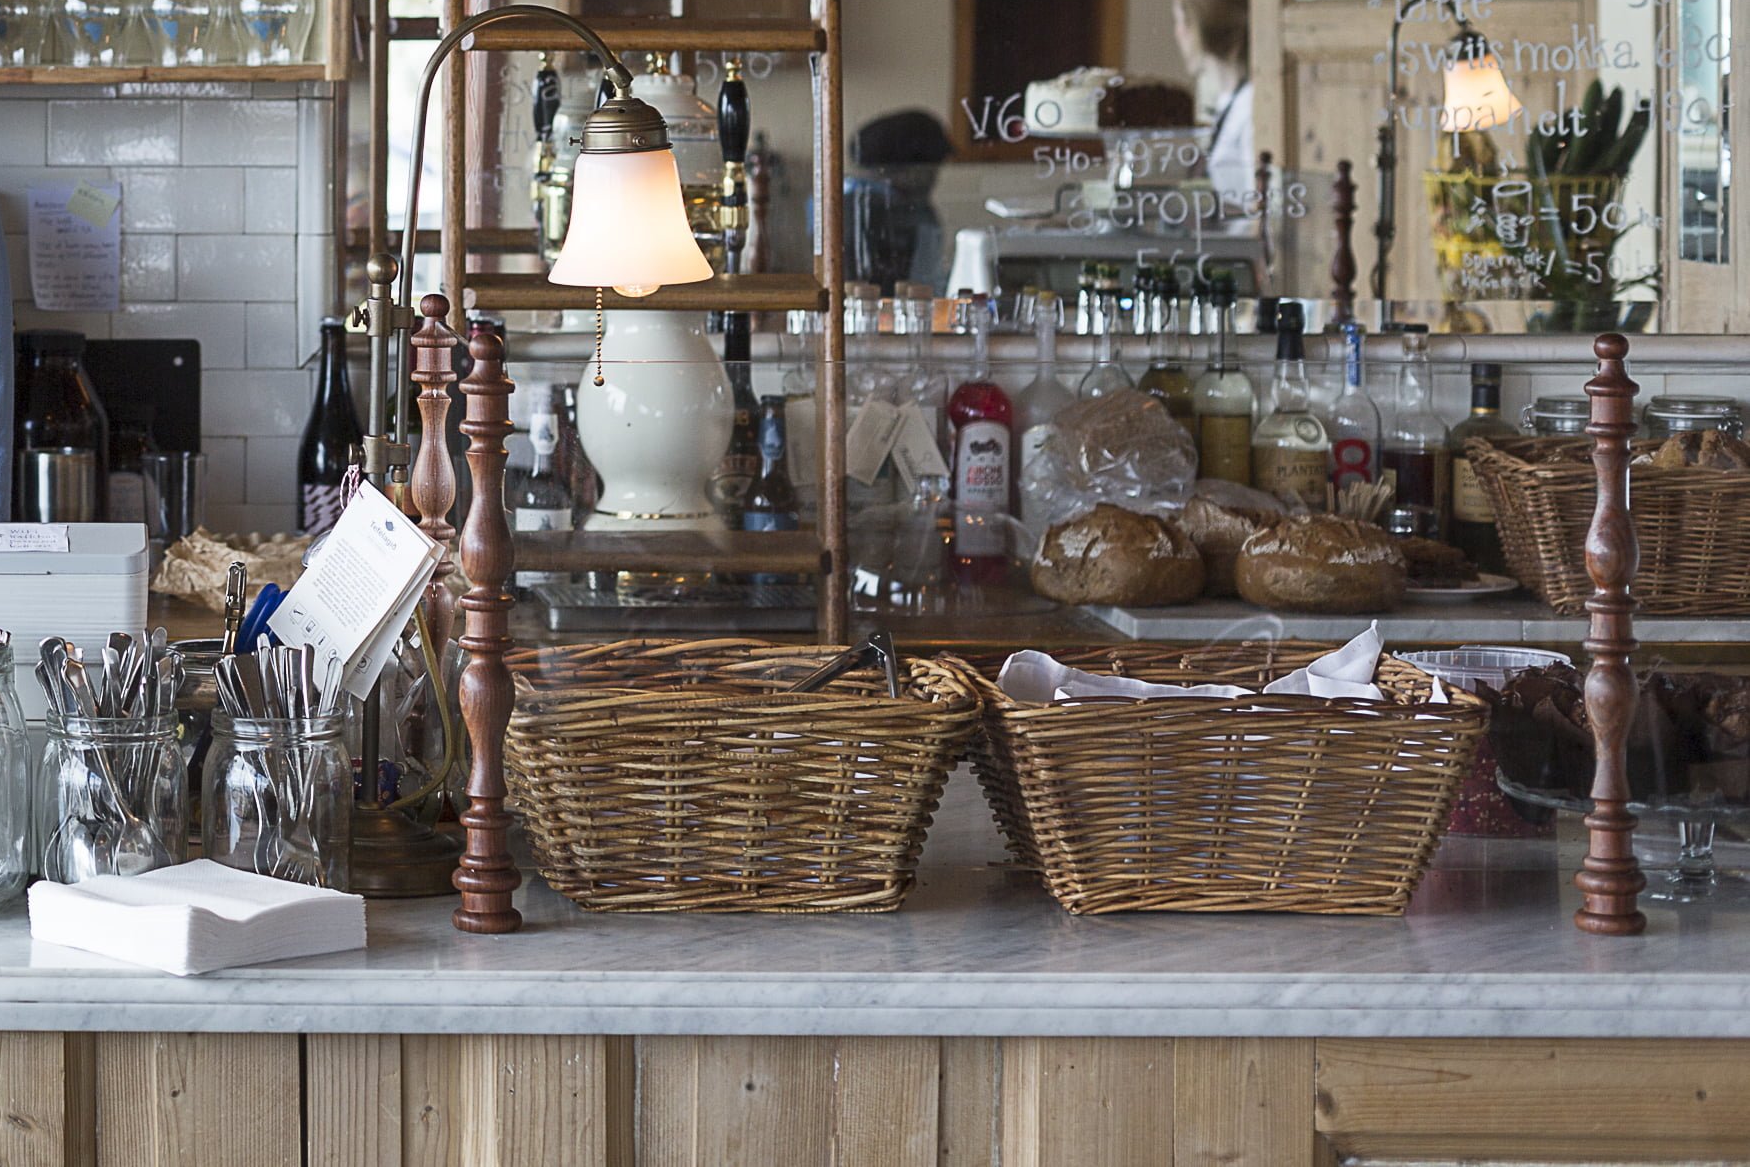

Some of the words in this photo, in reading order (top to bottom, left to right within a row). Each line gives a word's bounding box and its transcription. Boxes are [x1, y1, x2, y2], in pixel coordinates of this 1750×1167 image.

[1513, 24, 1641, 73] mokka
[961, 92, 1062, 142] V60
[1066, 182, 1307, 254] aeropress
[1570, 194, 1628, 234] 50
